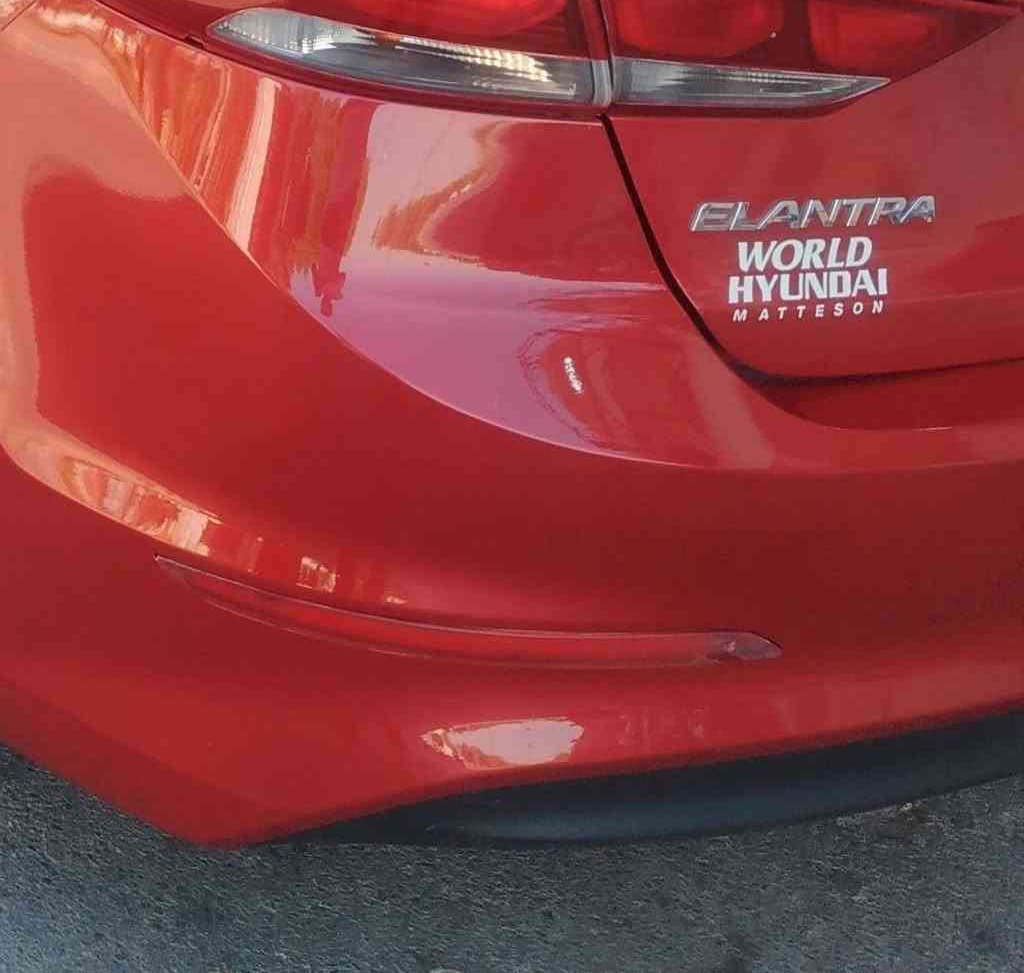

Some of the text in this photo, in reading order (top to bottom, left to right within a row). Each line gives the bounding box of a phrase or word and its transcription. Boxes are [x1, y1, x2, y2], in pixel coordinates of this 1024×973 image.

[690, 194, 937, 232] ELANTRA
[737, 236, 874, 272] WORLD
[728, 268, 889, 304] HYUNDAI
[732, 300, 884, 322] MATTESON
